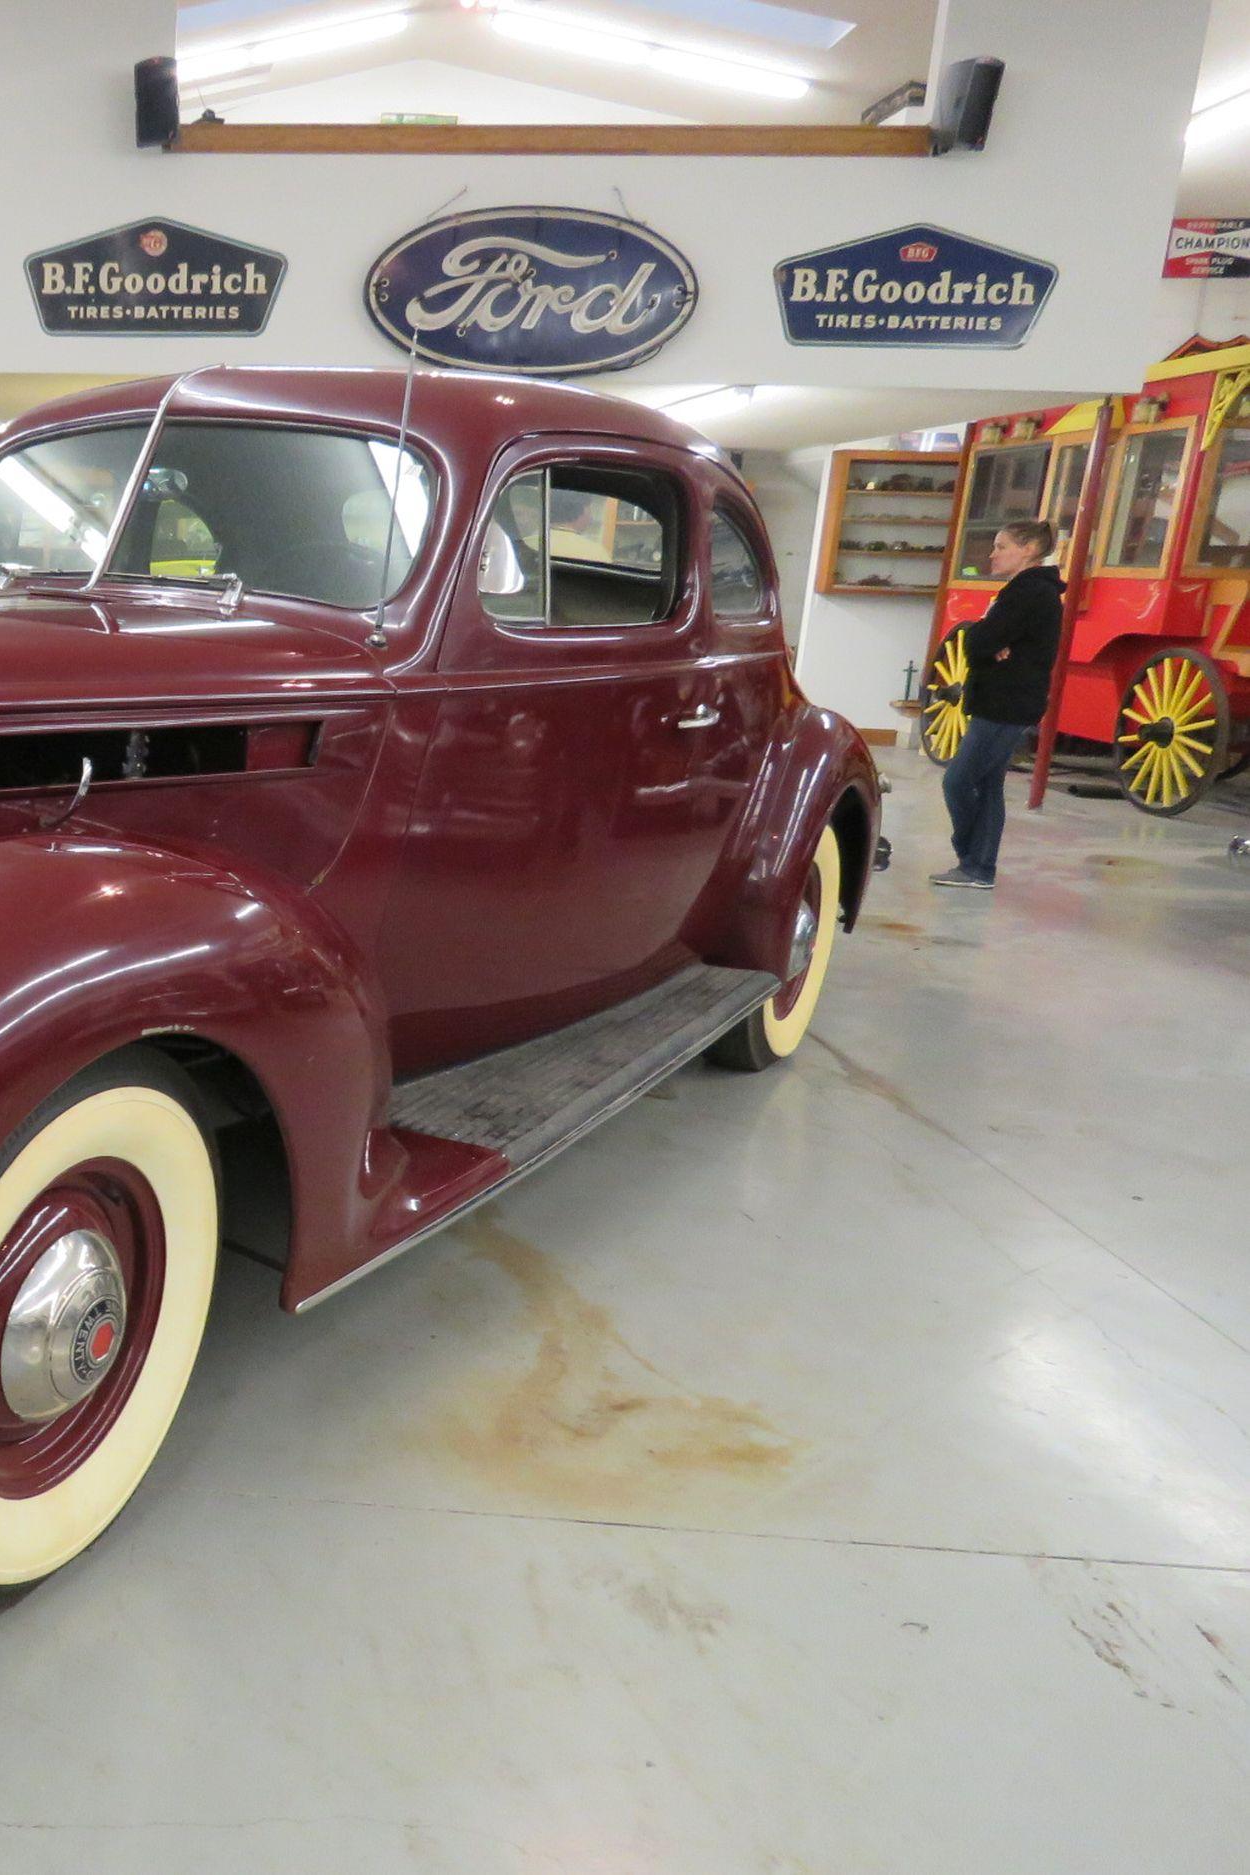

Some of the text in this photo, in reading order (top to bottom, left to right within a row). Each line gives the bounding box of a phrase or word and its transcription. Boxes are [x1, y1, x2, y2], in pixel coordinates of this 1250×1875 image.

[1175, 236, 1250, 250] CHAMPION
[1211, 257, 1234, 266] PLUG
[405, 236, 660, 335] Ford
